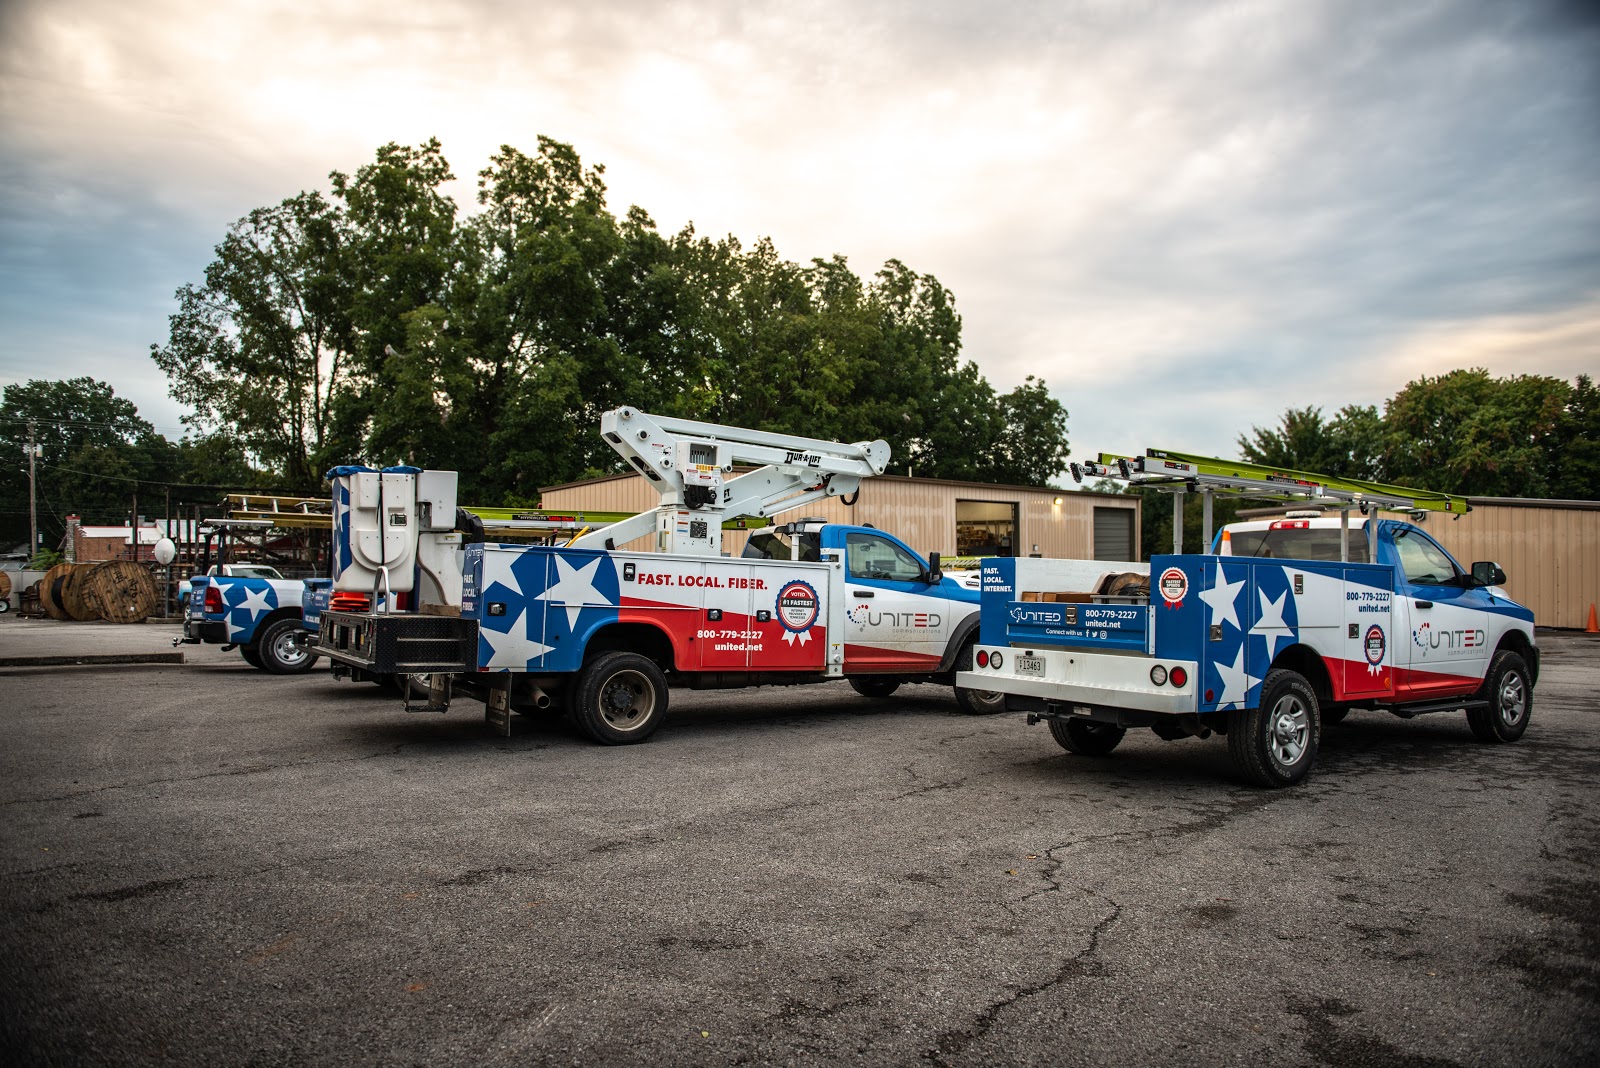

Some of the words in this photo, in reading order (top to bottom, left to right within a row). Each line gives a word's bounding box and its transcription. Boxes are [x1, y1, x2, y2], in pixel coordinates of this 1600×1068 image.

[984, 567, 999, 575] FAST.
[637, 573, 675, 586] FAST.
[678, 575, 725, 589] LOCAL.
[728, 577, 768, 590] FIBER.
[984, 576, 1004, 584] LOCAL.
[984, 585, 1013, 593] INTERNET.
[1346, 591, 1390, 602] 800-779-2227
[1358, 604, 1390, 613] united.net
[1020, 611, 1061, 622] UNITED
[1085, 609, 1138, 619] 800-779-2227
[868, 612, 942, 628] UNITED
[1085, 620, 1121, 629] united.net
[697, 630, 763, 639] 800-779-2227
[1429, 629, 1485, 650] UNITED
[715, 642, 763, 651] united.net
[1023, 660, 1041, 671] 13463
